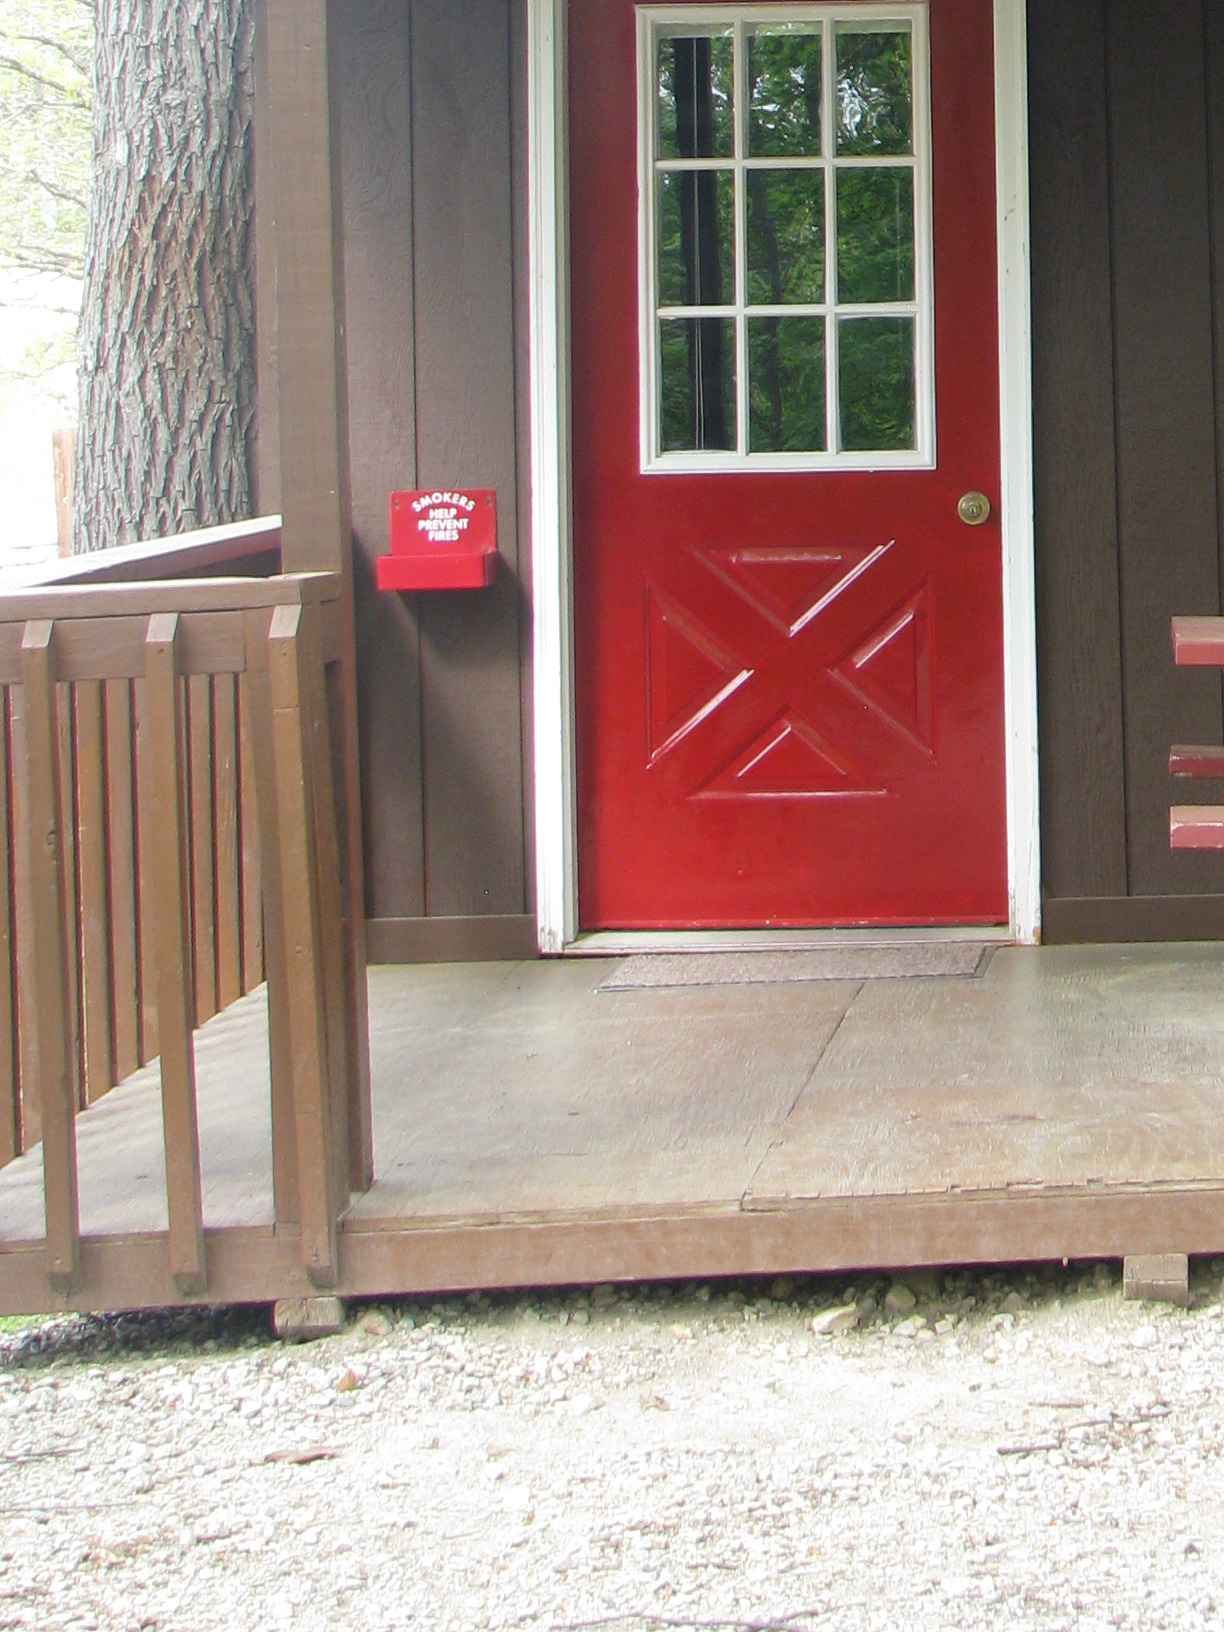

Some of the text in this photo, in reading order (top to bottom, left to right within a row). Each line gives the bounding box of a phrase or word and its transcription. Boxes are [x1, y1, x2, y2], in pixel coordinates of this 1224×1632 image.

[411, 492, 476, 512] SMOKERS
[428, 507, 458, 519] HELP
[417, 518, 470, 531] PREVENT
[428, 531, 459, 542] FIRES
